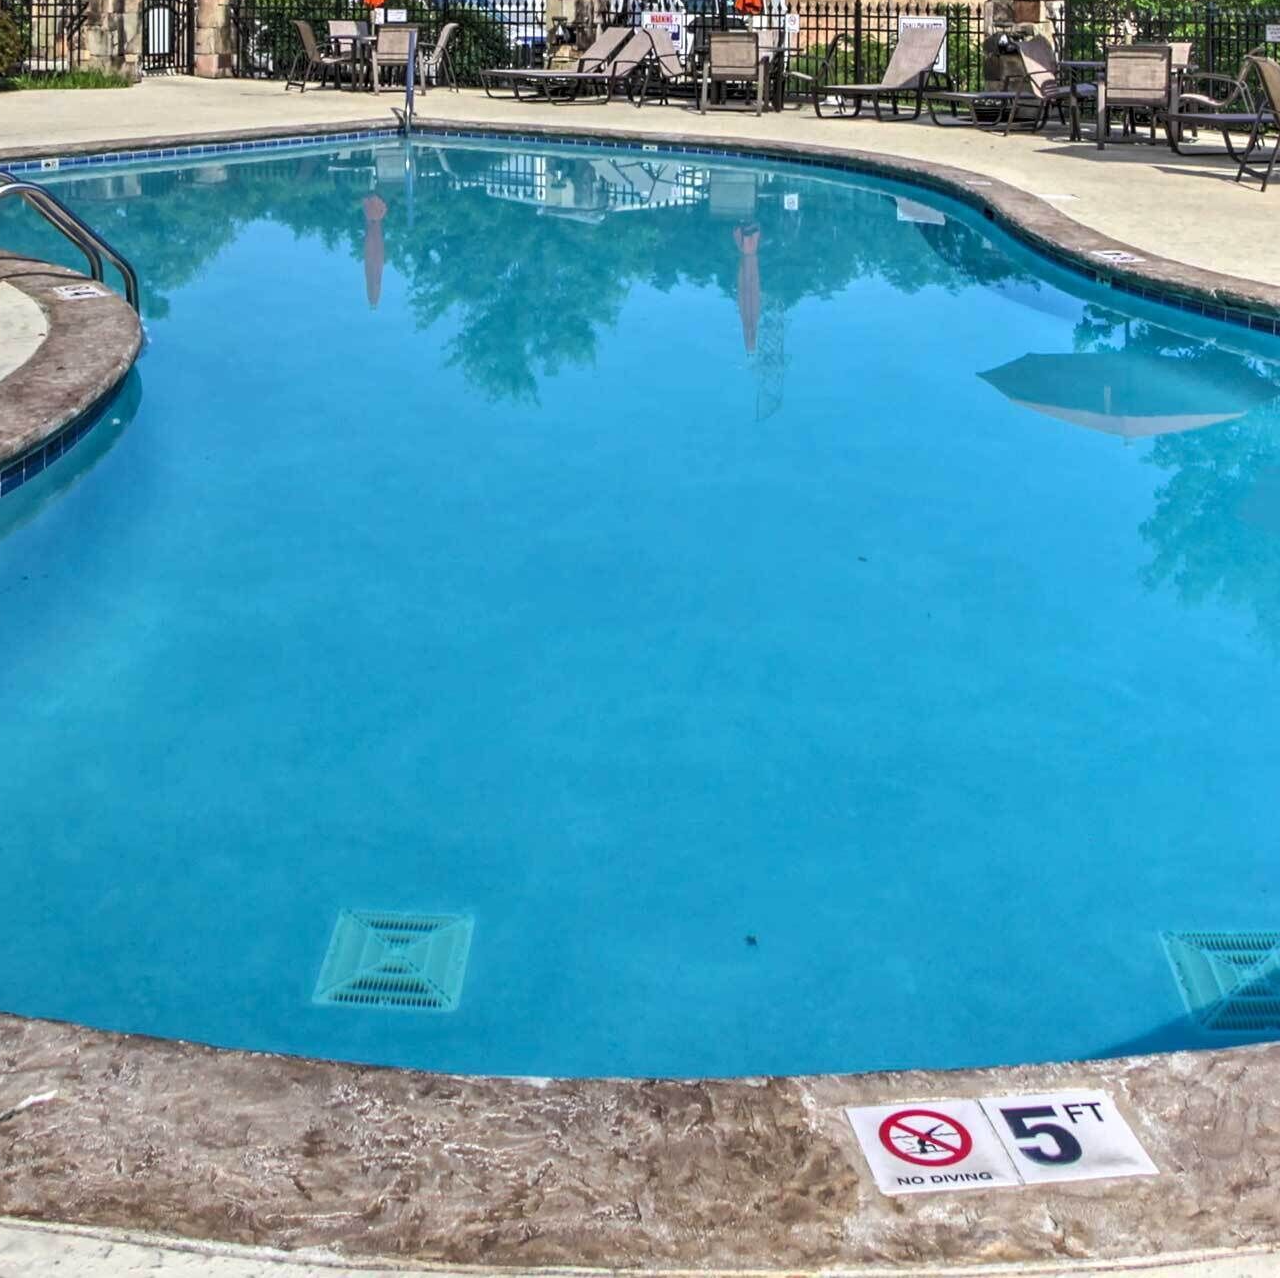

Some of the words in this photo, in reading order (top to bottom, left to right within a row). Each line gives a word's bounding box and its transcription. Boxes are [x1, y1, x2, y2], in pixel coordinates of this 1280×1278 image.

[999, 1104, 1083, 1167] 5
[1062, 1102, 1105, 1124] FT
[896, 1174, 925, 1186] NO
[931, 1171, 993, 1184] DIVING
